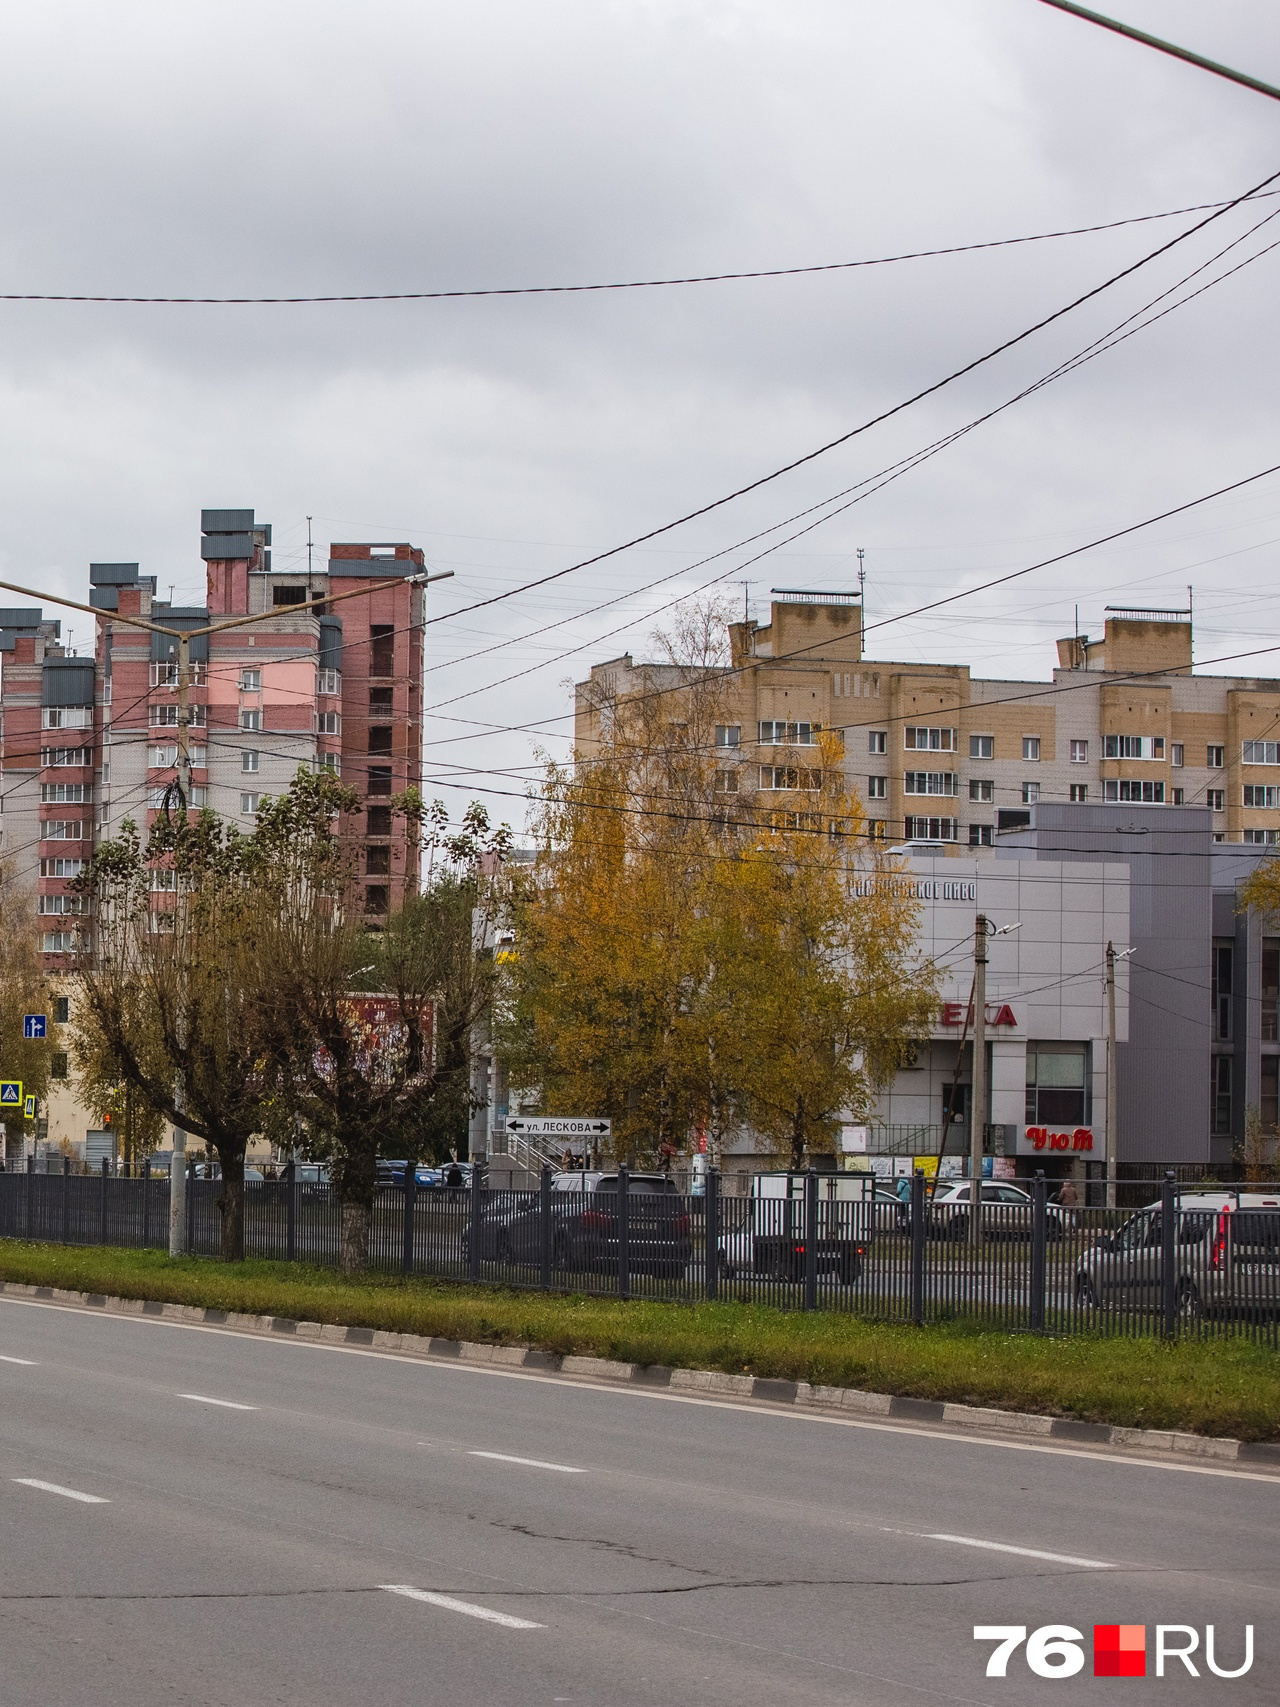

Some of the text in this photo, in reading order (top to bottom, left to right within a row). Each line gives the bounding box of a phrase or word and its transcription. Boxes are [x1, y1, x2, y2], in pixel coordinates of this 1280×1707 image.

[943, 881, 977, 900] ПИВО
[526, 1122, 592, 1132] ул. ЛЕСКОВА
[1025, 1127, 1093, 1150] Уют
